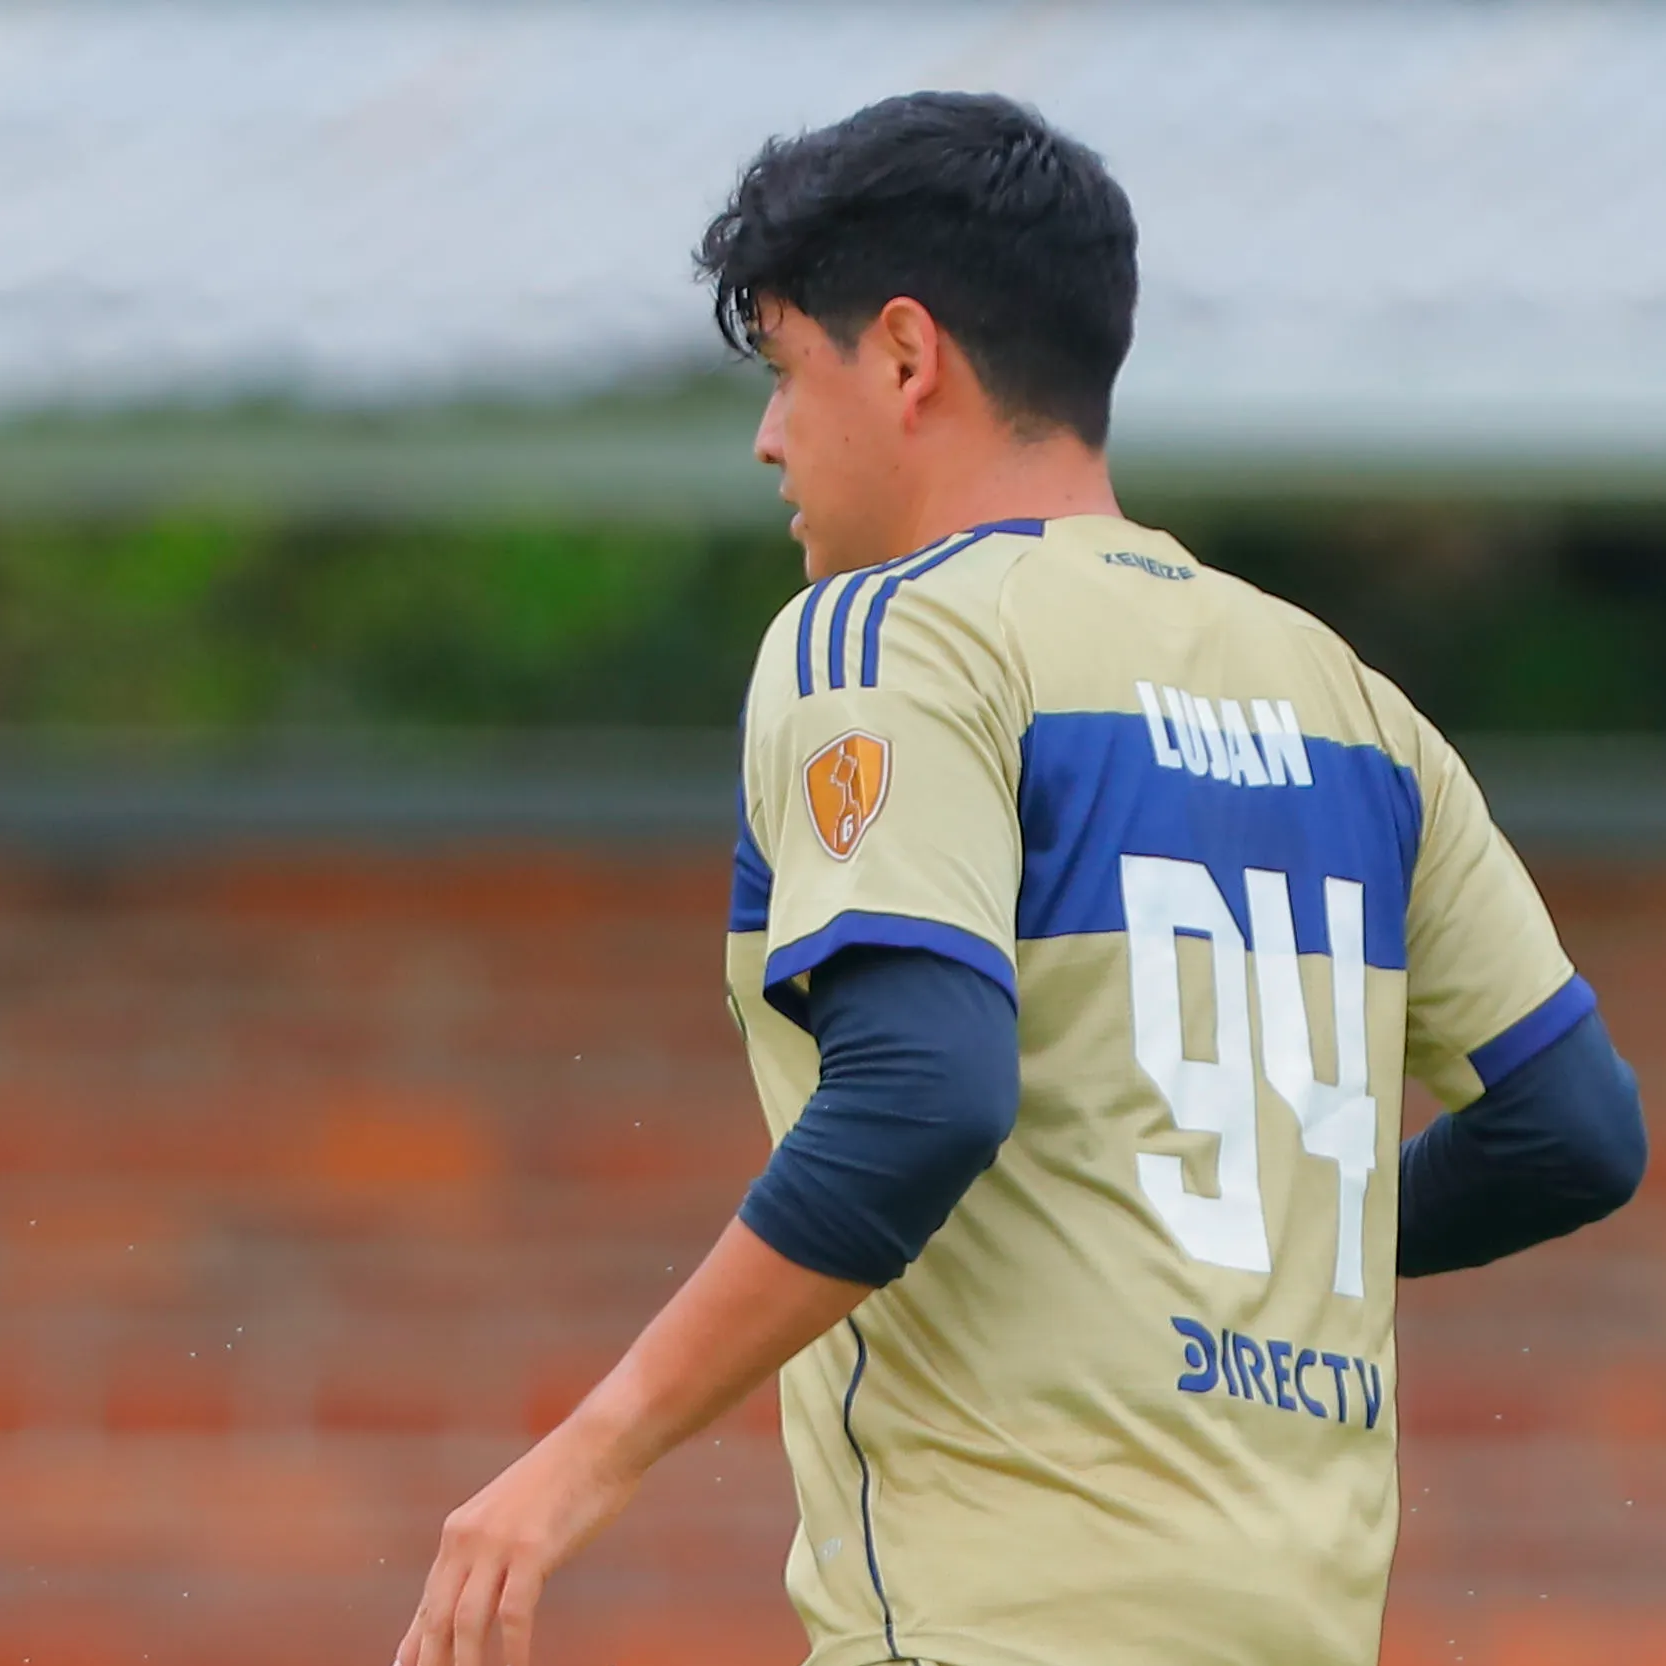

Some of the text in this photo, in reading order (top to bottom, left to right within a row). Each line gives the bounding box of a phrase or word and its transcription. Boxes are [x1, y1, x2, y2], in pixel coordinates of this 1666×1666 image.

[1135, 681, 1314, 787] LUJAN
[1120, 853, 1376, 1298] 94
[1171, 1316, 1382, 1429] DIRECTV
